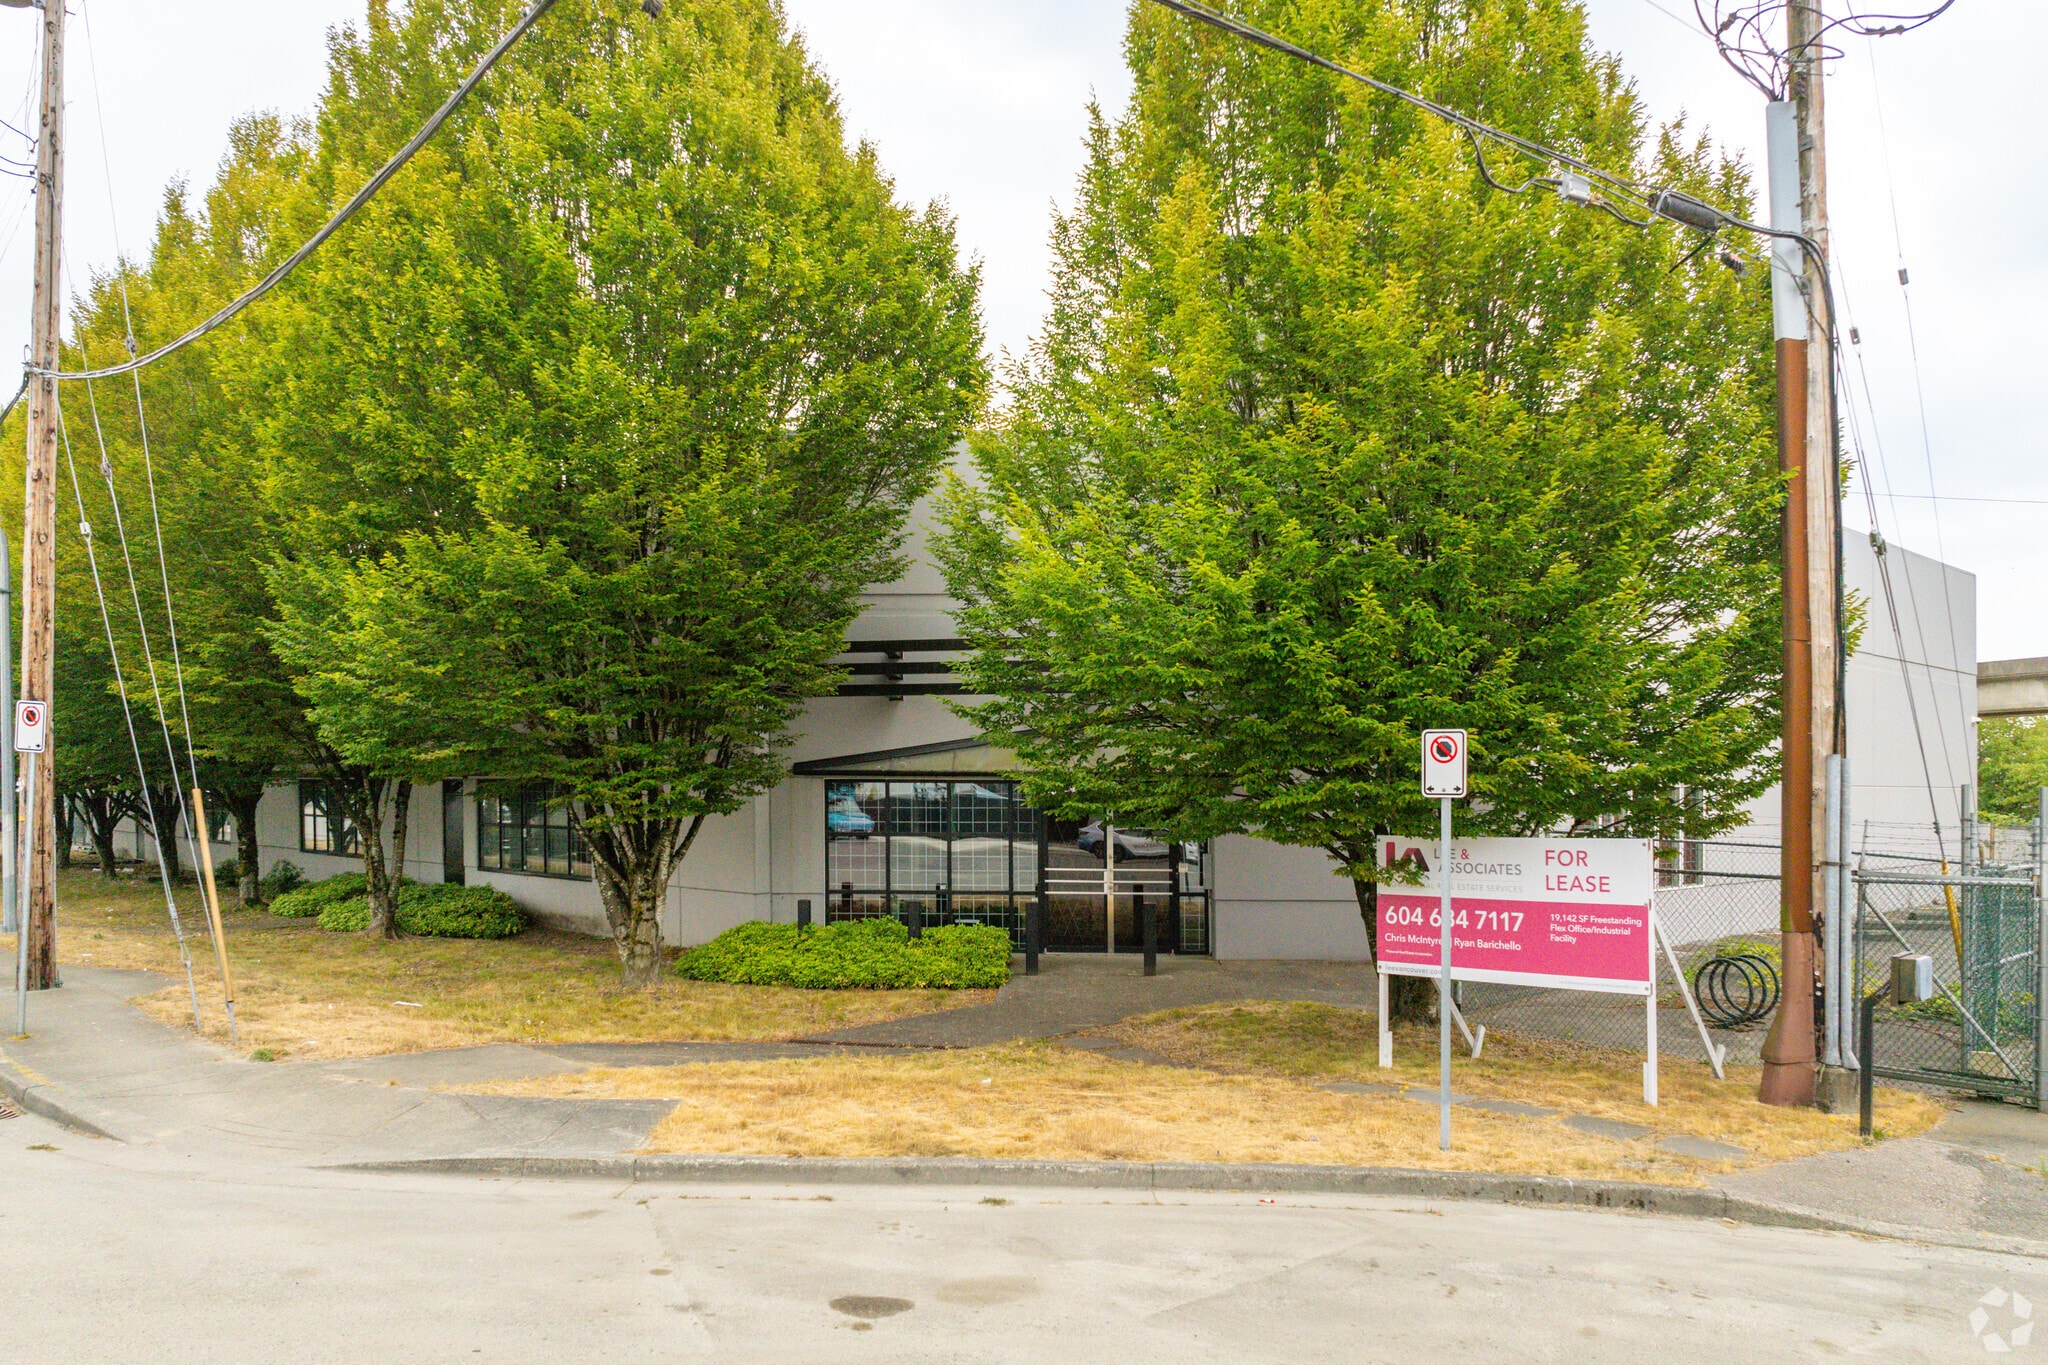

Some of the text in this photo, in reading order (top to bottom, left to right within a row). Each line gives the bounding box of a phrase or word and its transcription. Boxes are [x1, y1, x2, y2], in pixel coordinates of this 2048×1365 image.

[1434, 848, 1470, 860] LE &
[1545, 849, 1588, 867] FOR
[1457, 883, 1484, 892] ESTATE
[1486, 884, 1524, 894] SERVICES
[1545, 874, 1611, 893] LEASE
[1385, 905, 1424, 926] 604
[1474, 910, 1524, 932] 7117
[1550, 913, 1642, 927] 19,142 SF Freestanding
[1550, 923, 1631, 936] Flex Office/Industrial
[1384, 932, 1406, 943] Chris
[1454, 937, 1475, 949] Ryan
[1477, 939, 1522, 951] Barichello
[1550, 933, 1577, 945] Facility
